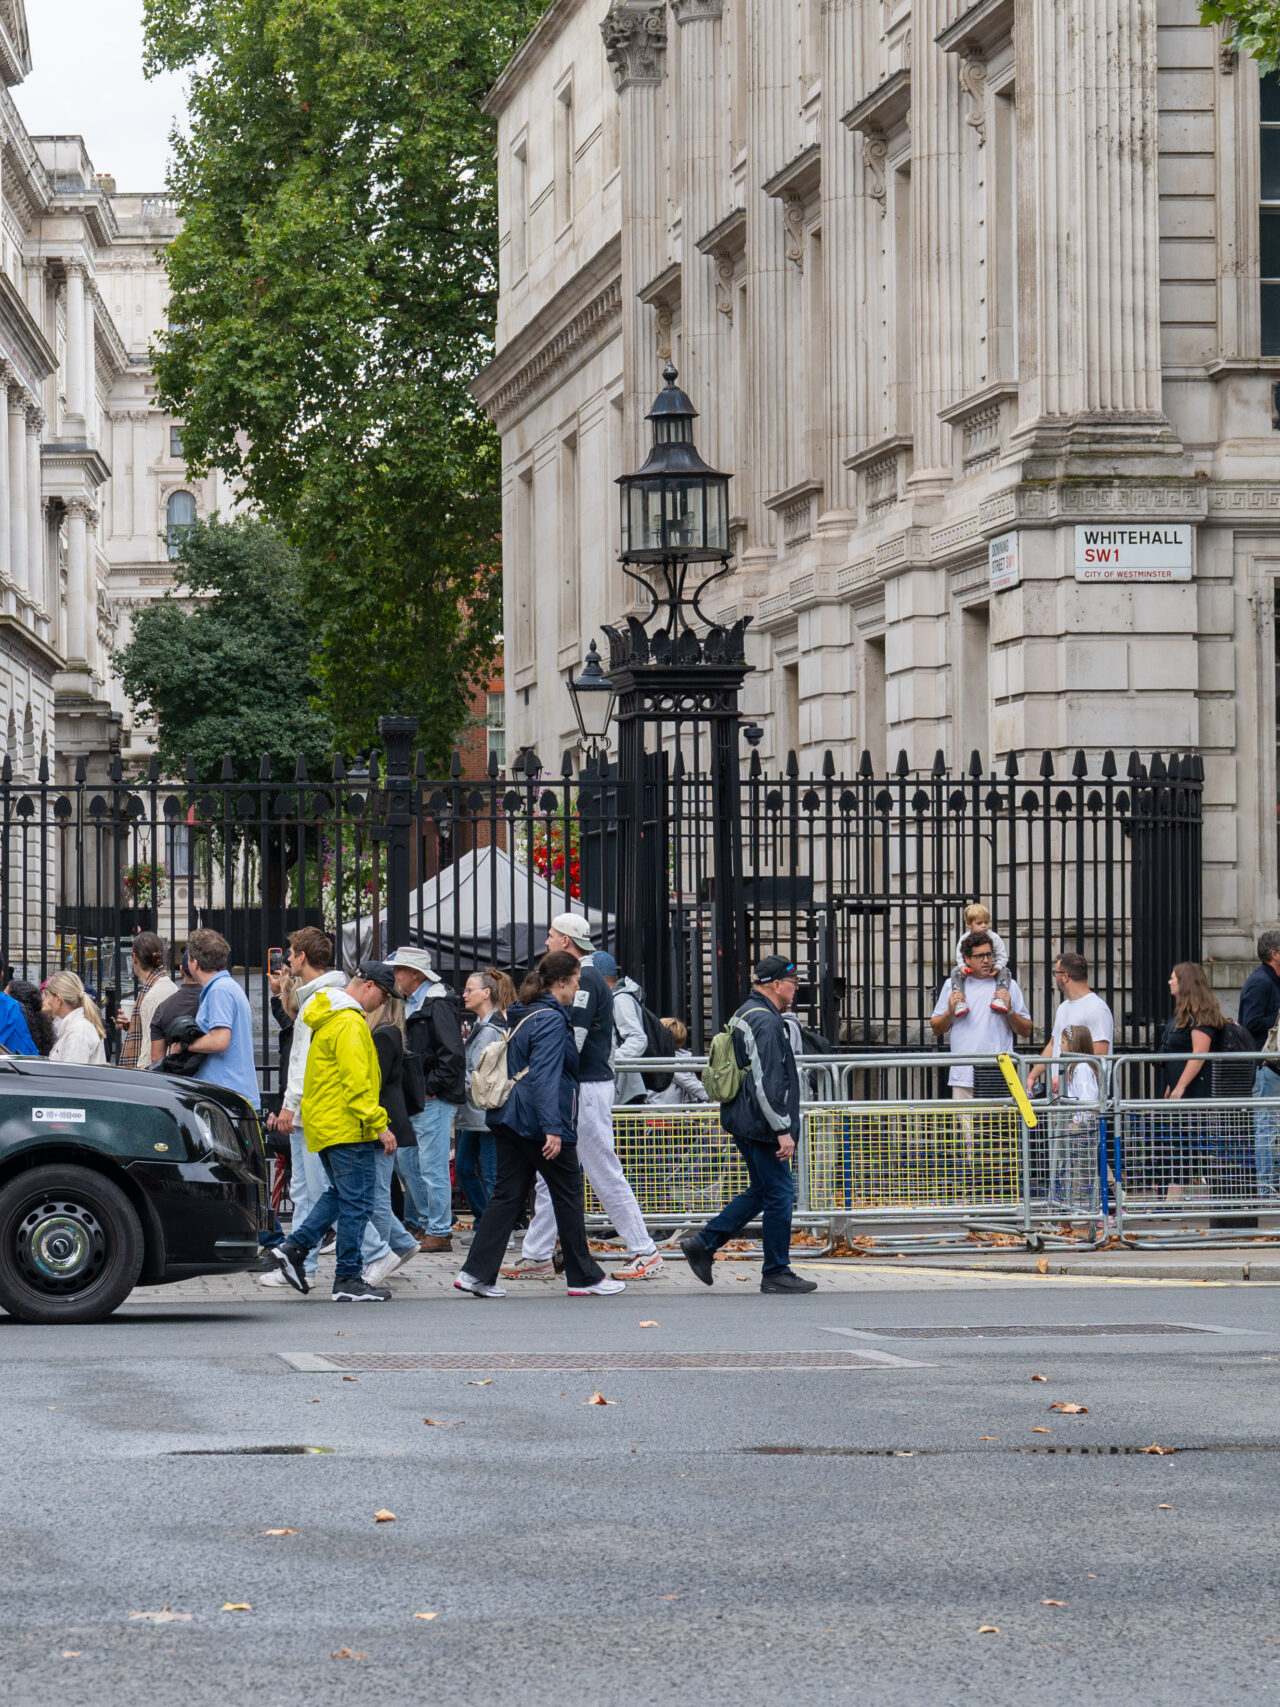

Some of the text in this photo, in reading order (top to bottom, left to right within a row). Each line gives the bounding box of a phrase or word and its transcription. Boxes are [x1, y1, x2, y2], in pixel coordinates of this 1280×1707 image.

[1084, 531, 1183, 545] WHITEHALL
[1084, 548, 1120, 563] SW1
[1084, 570, 1172, 578] CITY OF WESTMINSTER
